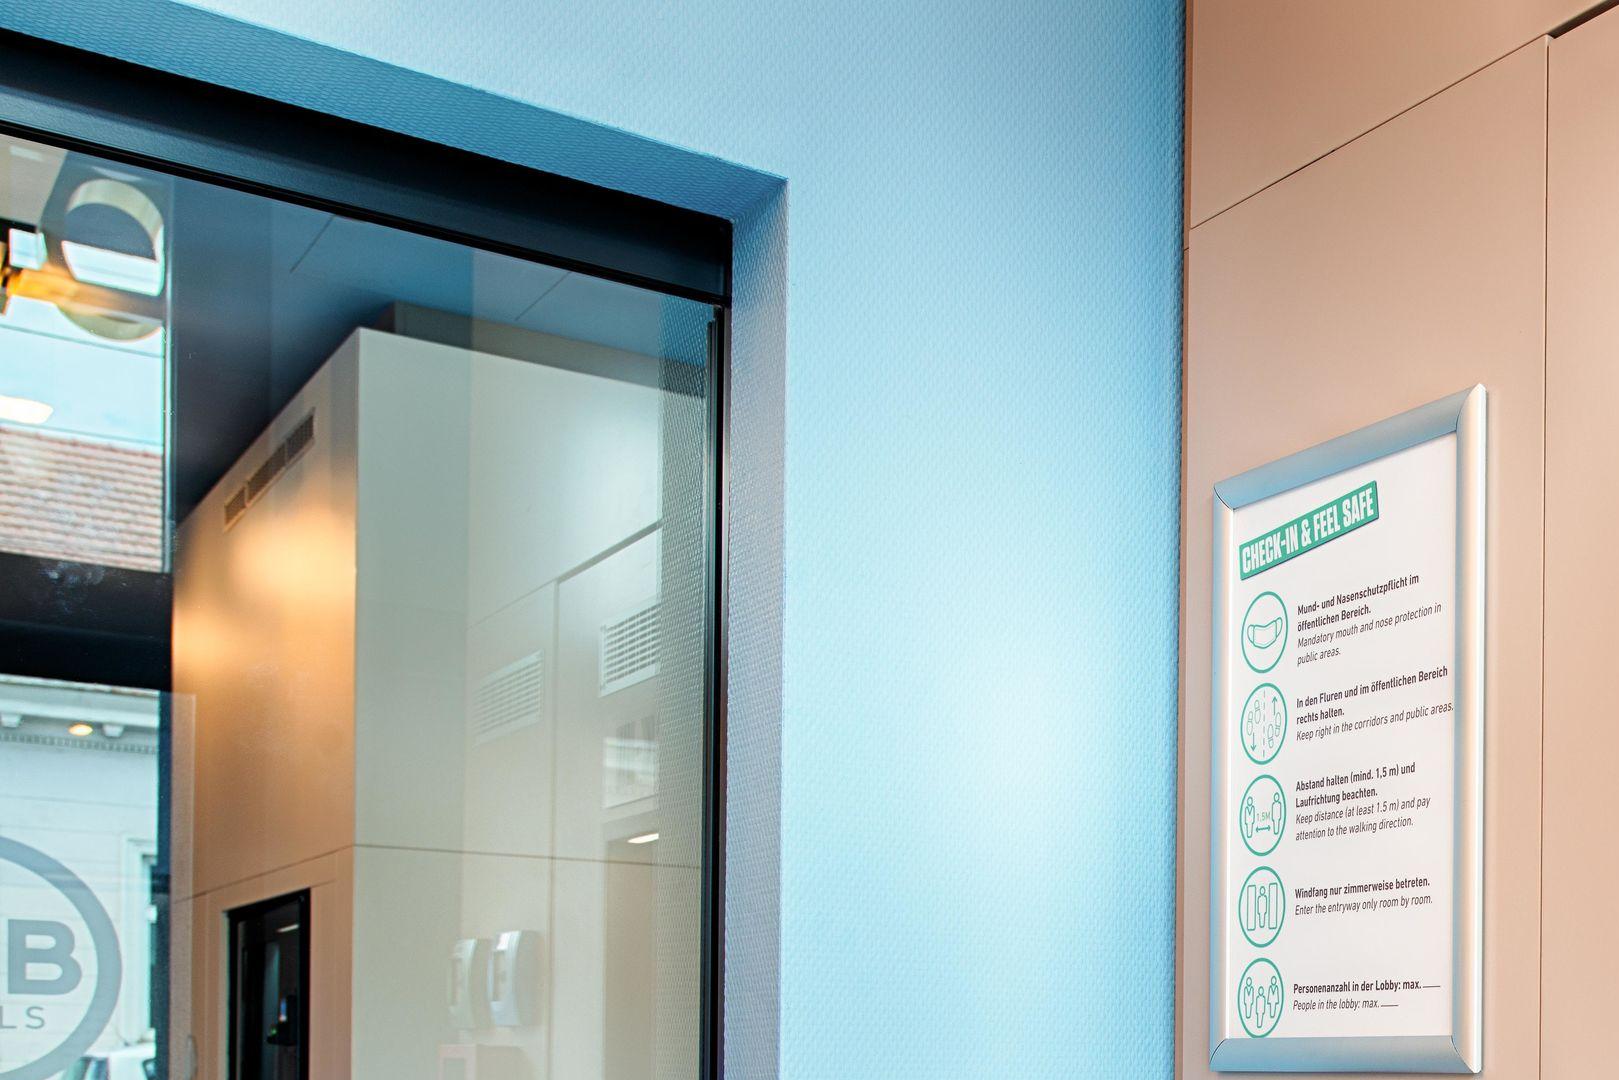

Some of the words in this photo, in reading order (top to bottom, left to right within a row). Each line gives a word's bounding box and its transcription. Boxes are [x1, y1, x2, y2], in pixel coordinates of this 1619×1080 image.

[1242, 523, 1299, 574] CHECK-IN
[1301, 518, 1312, 548] &
[1313, 504, 1341, 542] FEEL
[1342, 487, 1374, 528] SAFE
[1297, 600, 1320, 616] Mund-
[1321, 595, 1335, 609] und
[1336, 576, 1408, 605] Nasenschutzpflicht
[1409, 574, 1419, 585] im
[1297, 613, 1340, 632] öffentlichen
[1340, 603, 1371, 621] Bereich.
[1297, 632, 1335, 648] Mandatory
[1335, 623, 1358, 639] mouth
[1359, 618, 1374, 633] and
[1374, 616, 1393, 629] nose
[1394, 605, 1433, 627] protection
[1434, 602, 1442, 613] in
[1296, 650, 1318, 667] public
[1319, 647, 1341, 660] areas.
[1296, 698, 1304, 709] In
[1304, 695, 1318, 707] den
[1319, 691, 1343, 704] Fluren
[1344, 684, 1358, 698] und
[1359, 683, 1369, 695] im
[1370, 674, 1417, 693] öffentlichen
[1418, 665, 1448, 682] Bereich
[1296, 711, 1319, 725] rechts
[1319, 707, 1345, 720] halten.
[1296, 730, 1314, 741] Keep
[1314, 724, 1332, 740] right
[1332, 723, 1340, 734] in
[1341, 721, 1353, 733] the
[1354, 715, 1388, 730] corridors
[1389, 709, 1405, 724] and
[1405, 705, 1429, 723] public
[1430, 702, 1454, 714] areas.
[1295, 776, 1325, 792] Abstand
[1325, 774, 1349, 787] halten
[1350, 768, 1374, 784] (mind.
[1388, 763, 1399, 777] m)
[1400, 761, 1416, 775] und
[1295, 793, 1341, 808] Laufrichtung
[1341, 787, 1378, 801] beachten.
[1295, 813, 1313, 825] Keep
[1313, 809, 1344, 823] distance
[1344, 805, 1355, 819] (at
[1355, 803, 1375, 816] least
[1376, 800, 1388, 814] 1.5
[1388, 798, 1400, 812] m)
[1400, 796, 1415, 810] and
[1416, 797, 1431, 810] pay
[1295, 827, 1326, 841] attention
[1327, 826, 1335, 838] to
[1335, 824, 1348, 836] the
[1348, 820, 1377, 834] walking
[1378, 816, 1413, 830] direction.
[1294, 886, 1328, 899] Windfang
[1329, 886, 1343, 896] nur
[1343, 879, 1394, 894] zimmerweise
[1395, 876, 1430, 890] betreten.
[1294, 904, 1314, 916] Enter
[1315, 902, 1327, 914] the
[1327, 901, 1361, 914] entryway
[1361, 897, 1378, 911] only
[1378, 898, 1399, 908] room
[1400, 895, 1410, 908] by
[1410, 895, 1433, 905] room.
[8, 919, 82, 995] B
[1293, 981, 1351, 994] Personenanzahl
[1351, 980, 1359, 992] in
[1360, 980, 1374, 992] der
[1375, 979, 1401, 993] Lobby:
[1402, 980, 1422, 990] max.
[1292, 999, 1317, 1012] People
[1317, 998, 1325, 1010] in
[1324, 998, 1338, 1010] the
[1338, 997, 1361, 1011] lobby:
[1361, 999, 1380, 1008] max.
